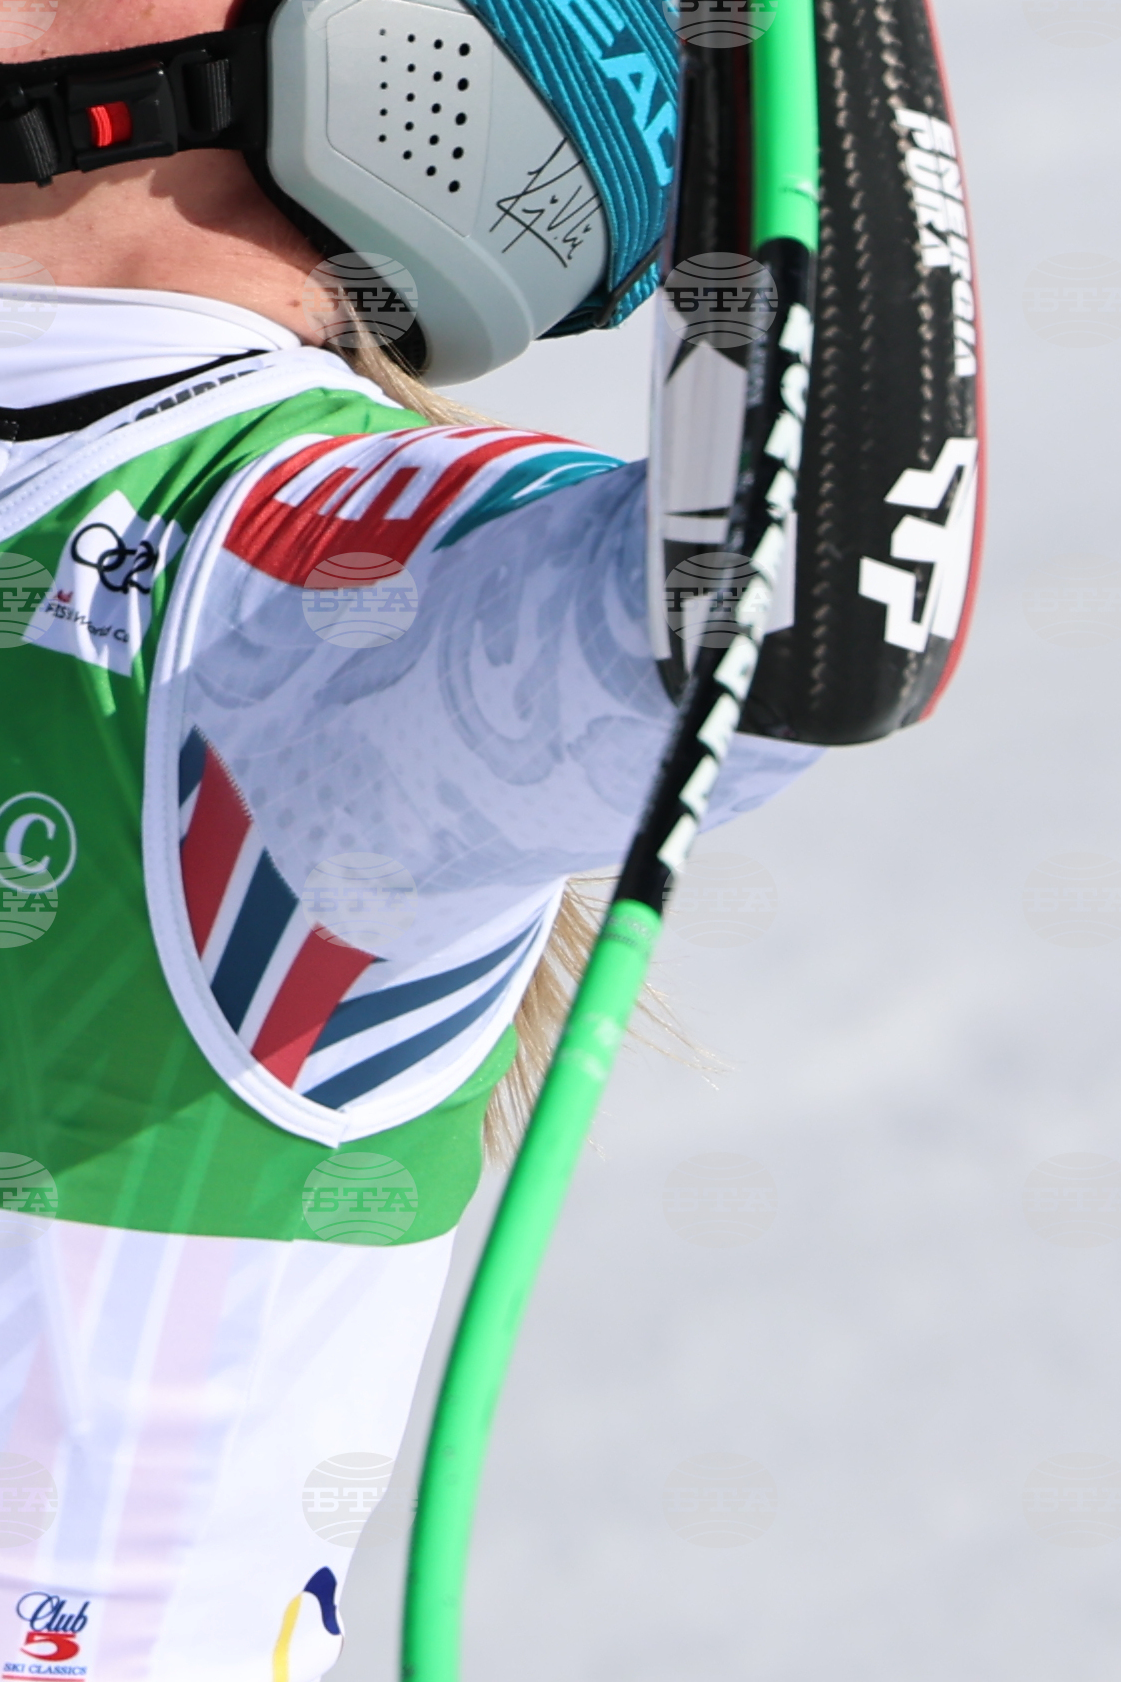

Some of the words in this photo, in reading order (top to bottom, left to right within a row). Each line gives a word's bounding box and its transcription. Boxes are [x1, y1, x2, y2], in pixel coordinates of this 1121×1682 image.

[15, 1591, 91, 1634] Club
[2, 1662, 26, 1673] SKI
[28, 1664, 88, 1676] CLASSICS
